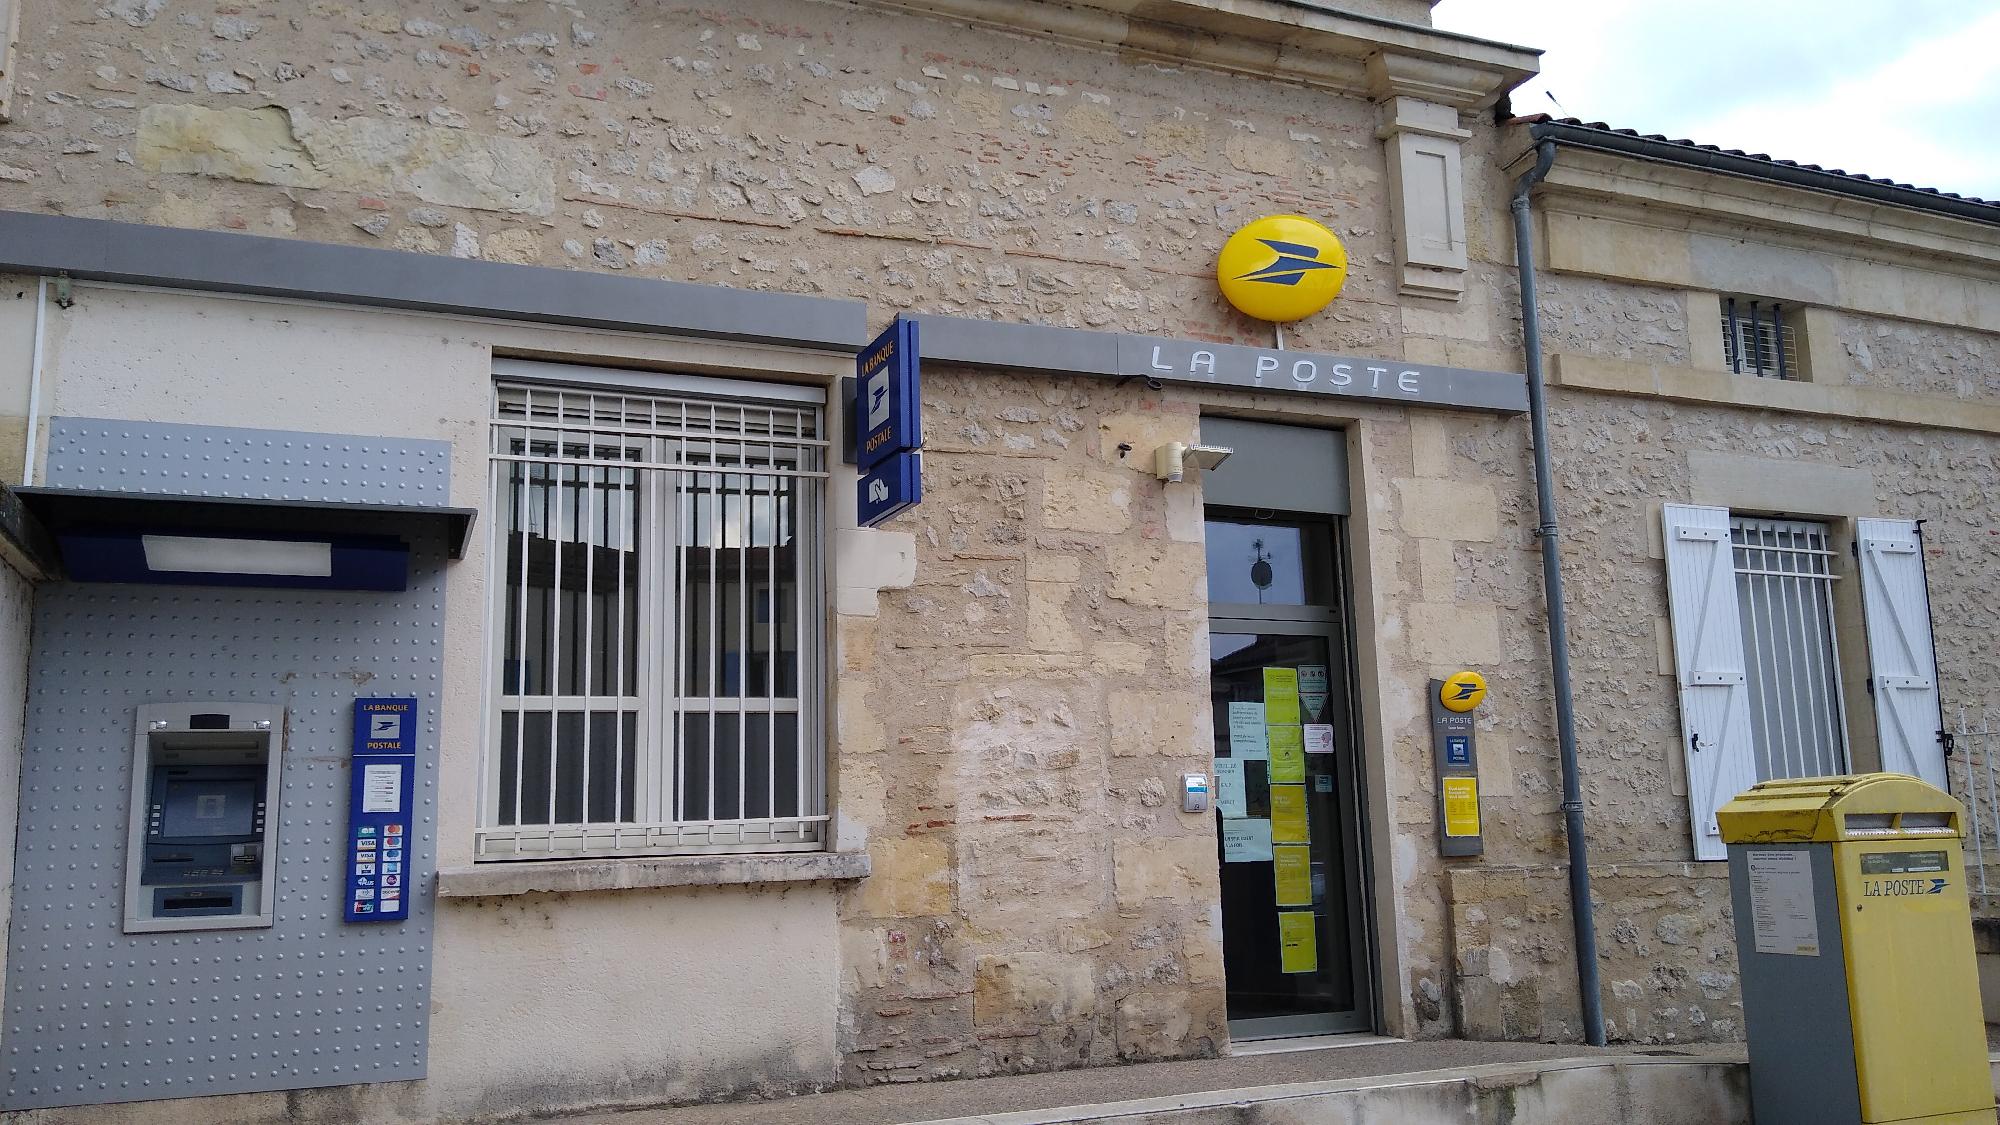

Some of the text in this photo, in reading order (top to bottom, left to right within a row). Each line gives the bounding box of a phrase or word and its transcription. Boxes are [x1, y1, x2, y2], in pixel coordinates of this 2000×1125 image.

[861, 340, 895, 378] LA BANQUE
[1151, 345, 1421, 393] LA POSTE
[866, 425, 893, 454] POSTALE
[367, 742, 401, 750] POSTALE
[1863, 879, 1925, 896] LA POSTE
